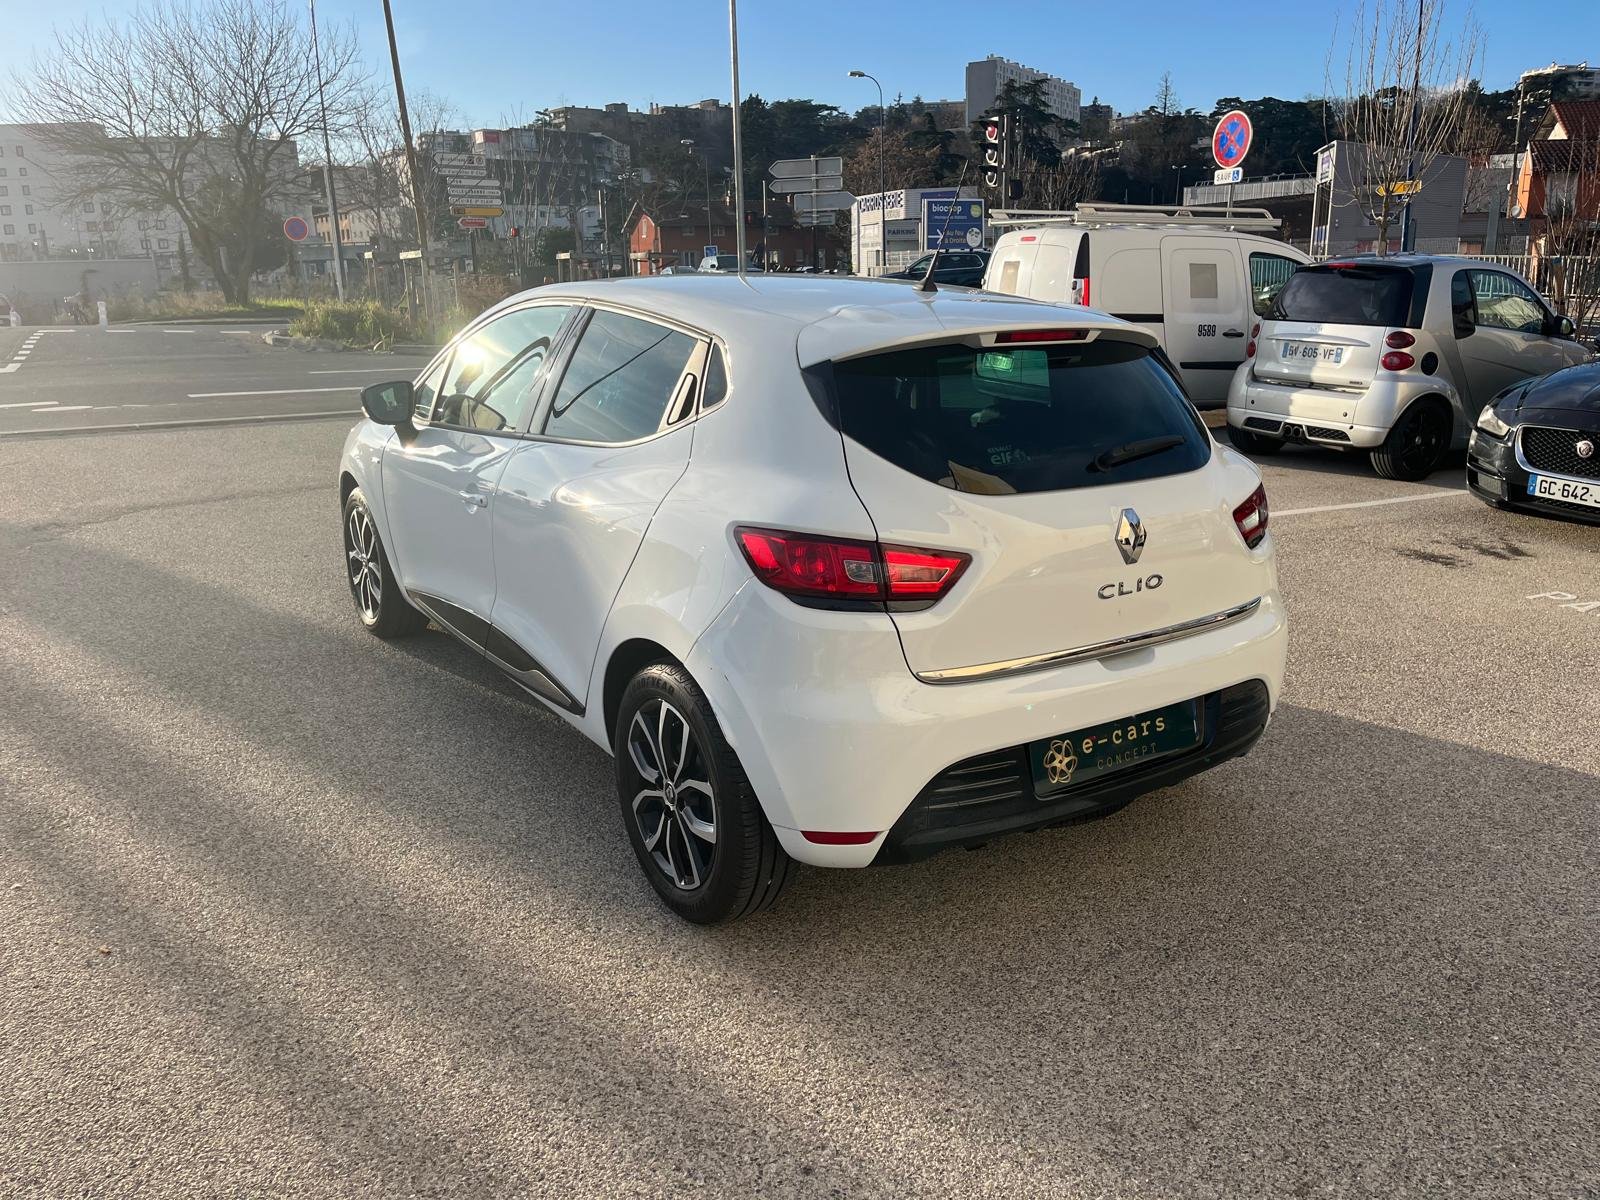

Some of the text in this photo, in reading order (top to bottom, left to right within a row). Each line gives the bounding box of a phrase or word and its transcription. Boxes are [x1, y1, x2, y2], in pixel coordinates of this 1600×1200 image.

[1216, 172, 1232, 182] SAUF
[1197, 324, 1217, 337] 9589
[1097, 574, 1164, 600] CLIO
[1081, 716, 1167, 754] e-cars
[1097, 742, 1157, 770] CONCEPT
